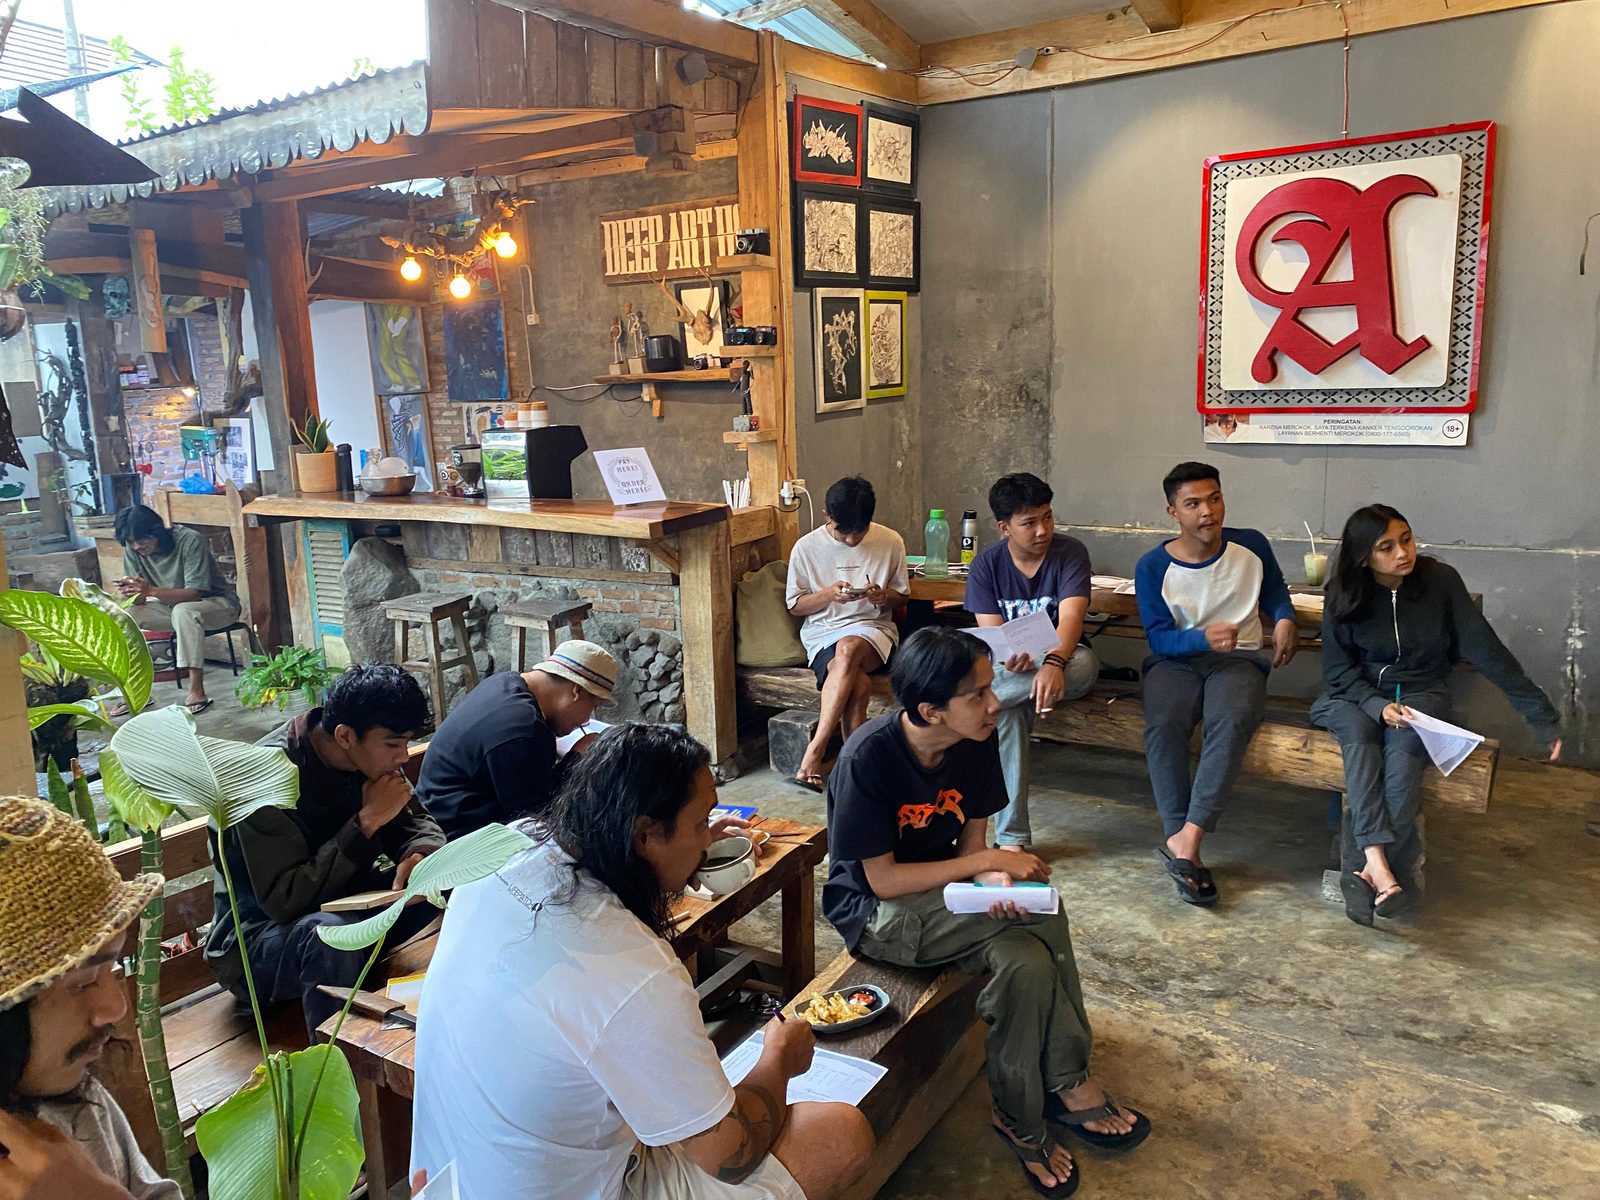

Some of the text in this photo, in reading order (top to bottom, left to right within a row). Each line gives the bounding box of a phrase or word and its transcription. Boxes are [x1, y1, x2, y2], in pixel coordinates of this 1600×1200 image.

[601, 214, 664, 275] DEEP
[666, 207, 713, 270] ART
[1446, 425, 1461, 433] 18+
